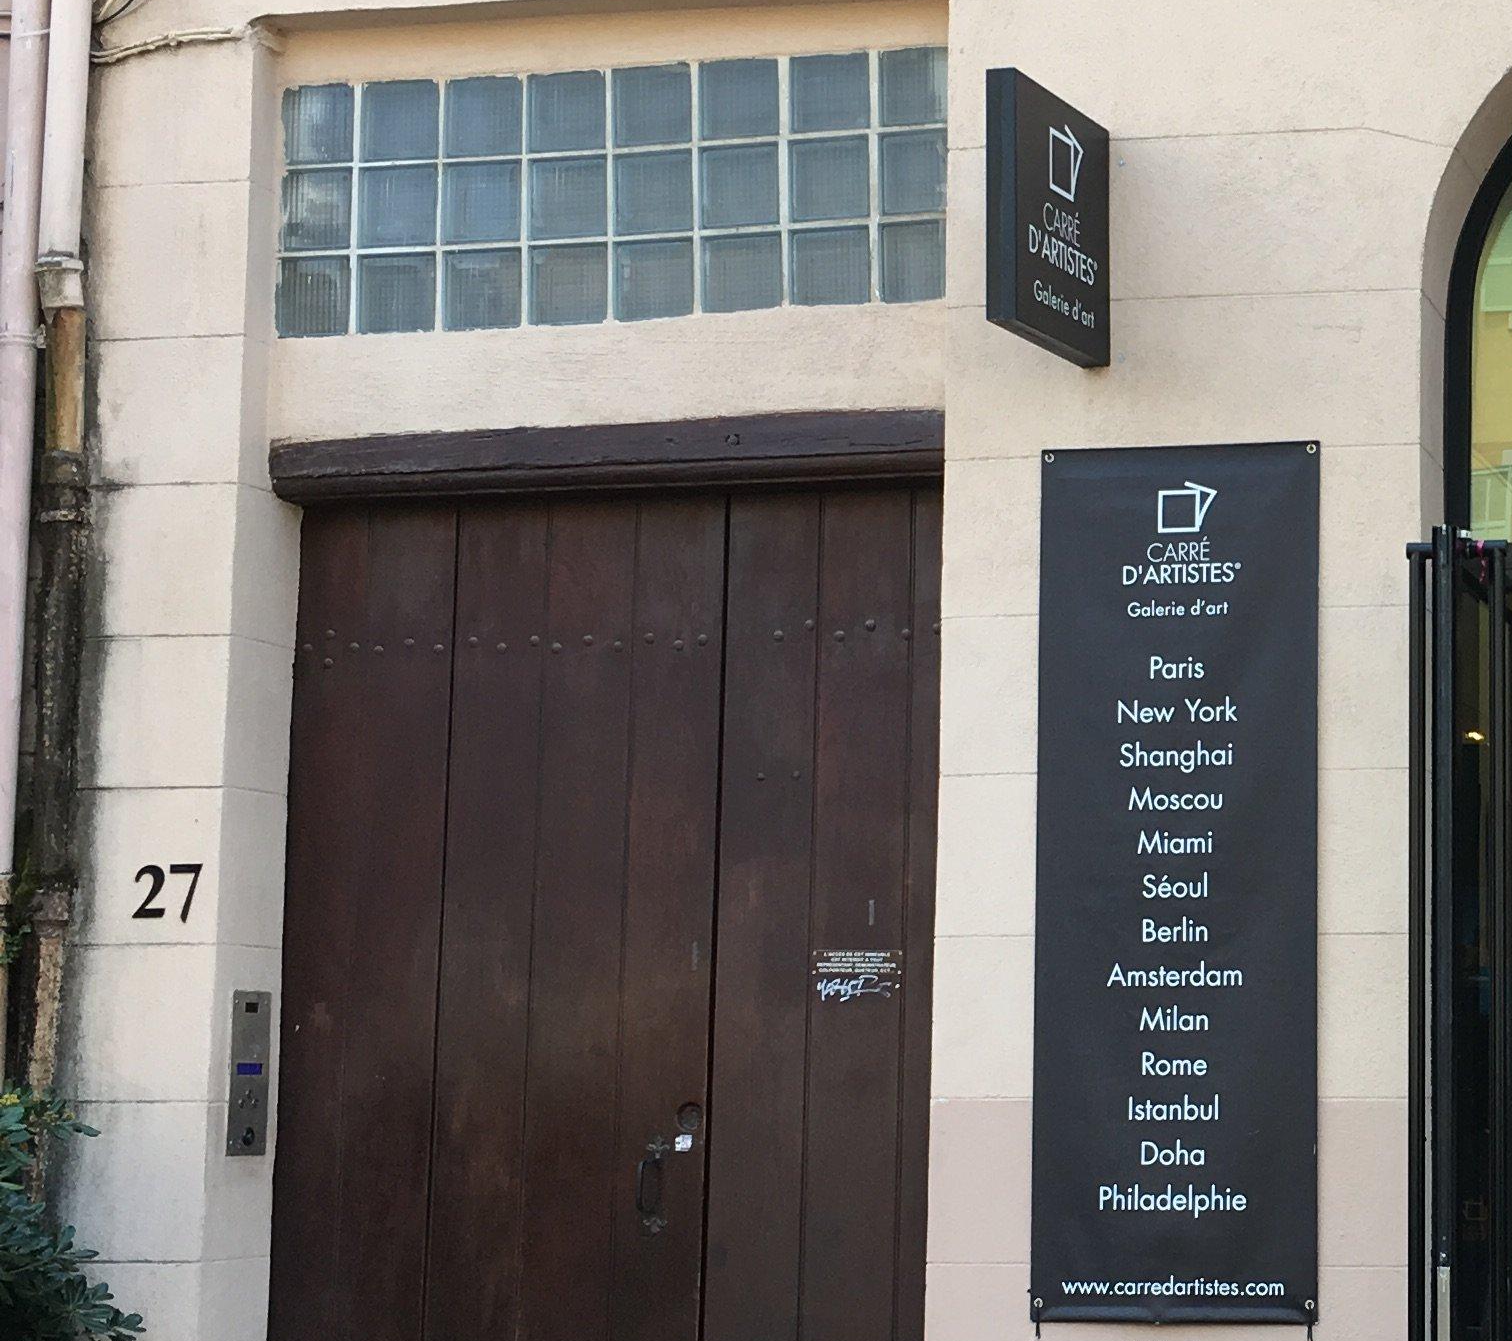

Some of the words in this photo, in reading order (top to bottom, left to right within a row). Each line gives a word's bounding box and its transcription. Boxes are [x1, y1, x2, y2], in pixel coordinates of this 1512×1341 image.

[1042, 201, 1081, 249] CARRÉ
[1033, 279, 1070, 317] Galerie
[1071, 298, 1095, 329] d'art
[1146, 535, 1211, 563] CARRÉ
[1127, 599, 1186, 618] Galerie
[1190, 598, 1229, 616] d'art
[1149, 655, 1205, 680] Paris
[1117, 699, 1175, 724] New
[1184, 696, 1238, 723] York
[1119, 740, 1233, 773] Shanghai
[1128, 786, 1223, 811] Moscou
[1137, 830, 1213, 855] Miami
[132, 863, 203, 924] 27
[1142, 872, 1209, 899] Séoul
[1142, 916, 1208, 943] Berlin
[1106, 960, 1244, 988] Amsterdam
[1139, 1005, 1209, 1032] Milan
[1141, 1051, 1208, 1076] Rome
[1128, 1094, 1219, 1121] Istanbul
[1140, 1139, 1205, 1166] Doha
[1099, 1184, 1247, 1219] Philadelphie
[1061, 1274, 1285, 1298] www.carredartistes.com
